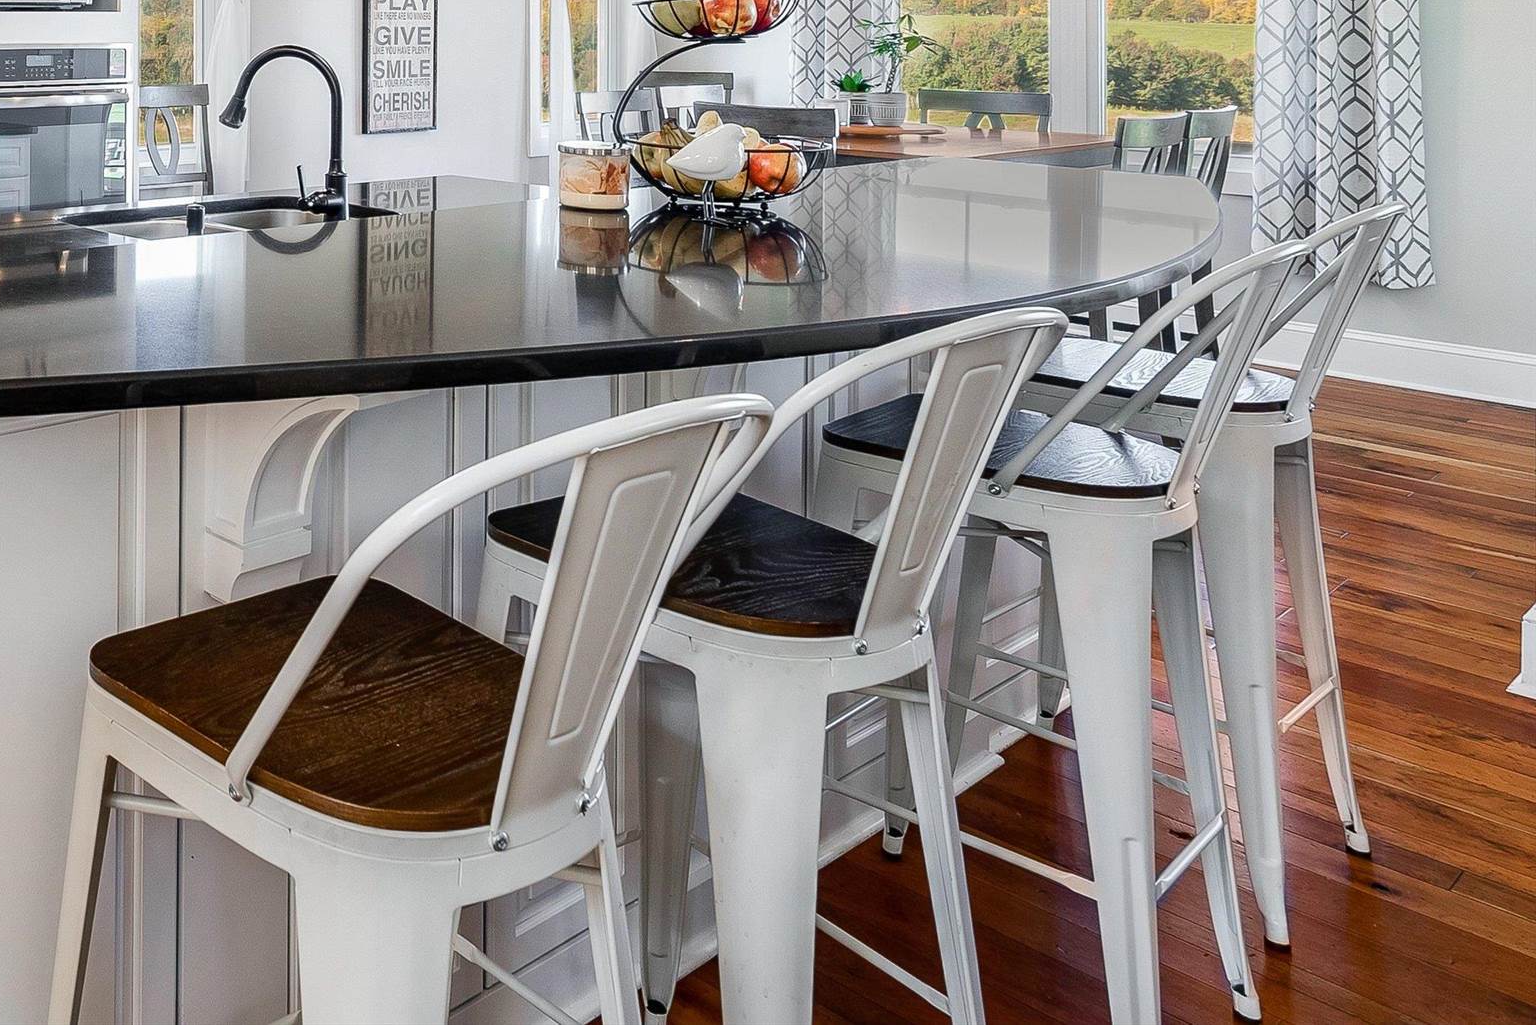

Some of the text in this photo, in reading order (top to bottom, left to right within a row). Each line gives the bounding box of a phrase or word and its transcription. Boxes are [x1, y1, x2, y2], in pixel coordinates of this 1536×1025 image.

[374, 26, 431, 46] GIVE
[373, 59, 431, 80] SMILE
[373, 91, 431, 113] CHERISH
